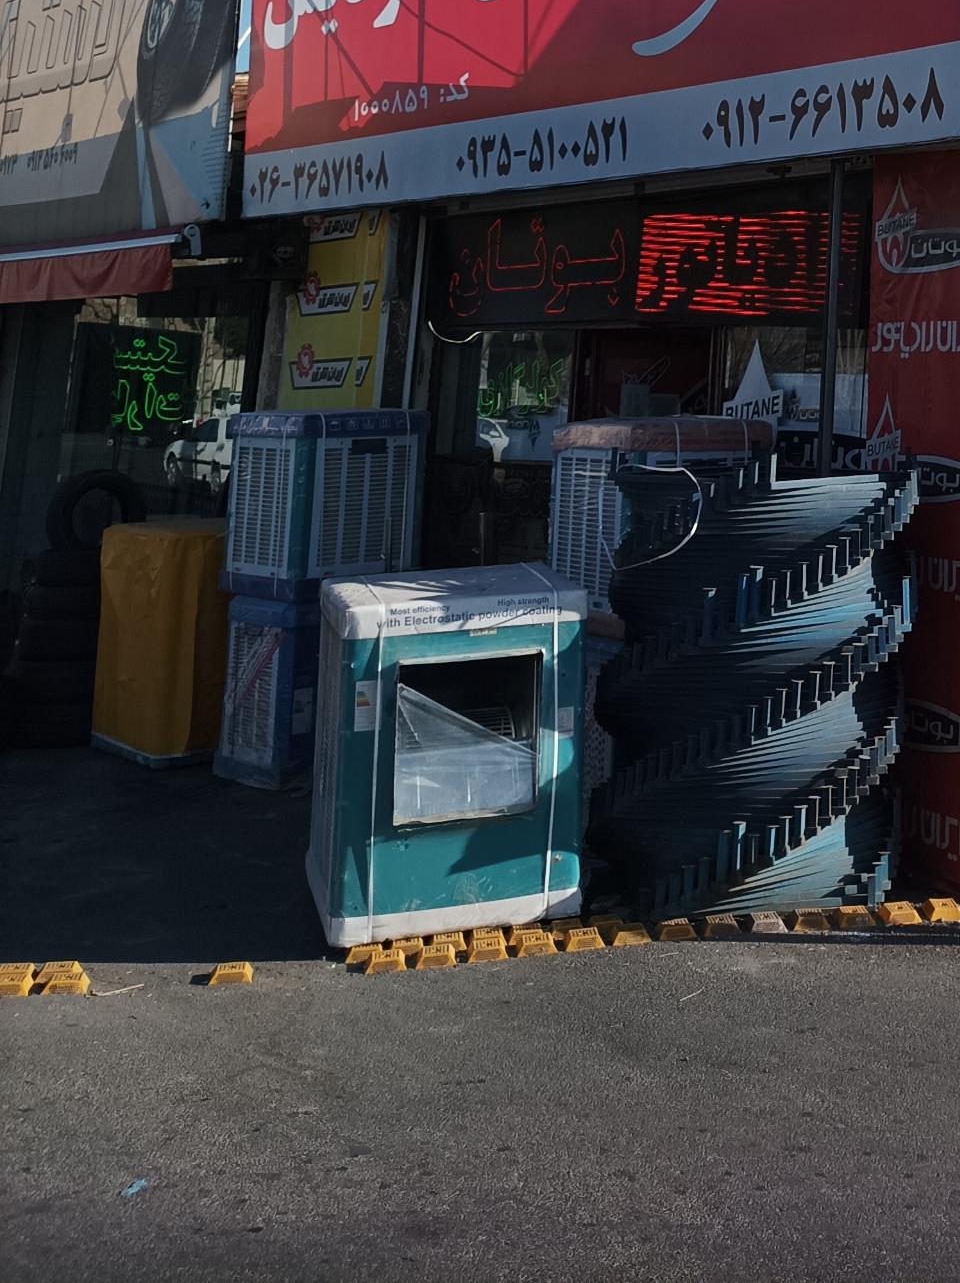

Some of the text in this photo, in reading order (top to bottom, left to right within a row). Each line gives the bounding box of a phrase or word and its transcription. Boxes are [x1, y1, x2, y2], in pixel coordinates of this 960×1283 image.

[353, 87, 428, 123] ۱۰۰۰۸۵۹
[701, 67, 945, 149] ۰۹۱۲-۶۶۱۳۵۰۸
[455, 117, 628, 179] ۰۹۳۵-۵۱۰۰۵۲۱
[249, 150, 390, 201] ۰۲۶-۳۶۵۷۱۹۰۸
[877, 212, 916, 237] BUTANE
[449, 217, 627, 317] بوتان
[871, 319, 934, 359] رادیاتور
[725, 395, 780, 419] BUTANE
[867, 435, 899, 459] BUTANE
[390, 604, 451, 616] Most efficiency
[404, 610, 476, 627] Electrostatic
[478, 607, 520, 622] powder
